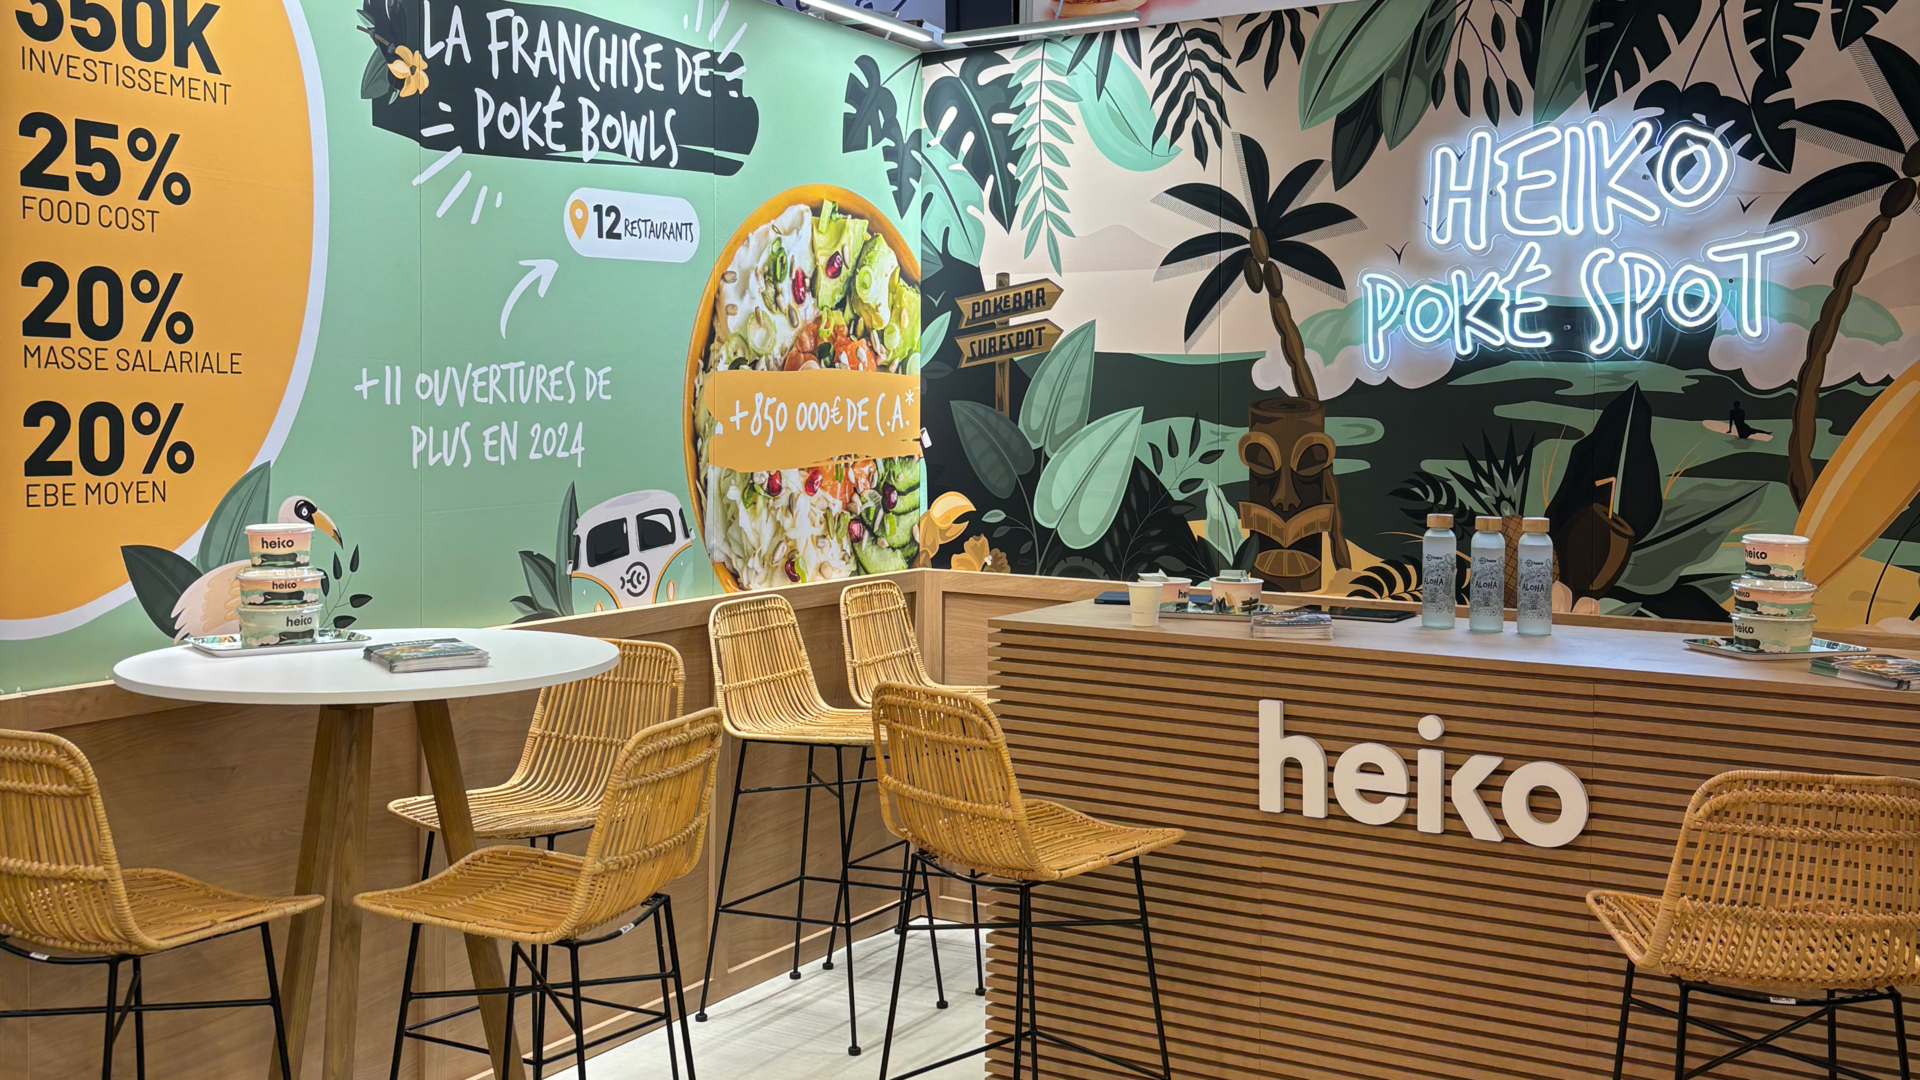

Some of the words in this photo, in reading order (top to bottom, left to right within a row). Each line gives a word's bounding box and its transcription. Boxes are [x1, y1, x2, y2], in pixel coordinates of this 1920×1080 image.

[423, 0, 472, 67] LA
[486, 8, 664, 94] FRANCHISE
[675, 47, 712, 98] DE
[21, 46, 232, 105] INVESTISSEMENT
[474, 85, 567, 151] POKÉ
[578, 96, 679, 168] BOWLS
[18, 111, 192, 206] 25%
[1431, 120, 1729, 250] HEIKO
[21, 195, 91, 226] FOOD
[98, 204, 160, 233] COST
[593, 203, 622, 241] 12
[624, 217, 694, 243] RESTAURANTS
[20, 260, 194, 345] 20%
[971, 286, 1047, 321] POKEBAR
[1362, 241, 1552, 364] POKÉ
[1580, 230, 1800, 354] SPOT
[23, 344, 109, 372] MASSE
[115, 348, 243, 375] SALARIALE
[969, 326, 1046, 360] SURFSPOT
[415, 360, 576, 408] OUVERTURES
[584, 366, 612, 402] DE
[23, 400, 195, 477] 20%
[729, 392, 788, 447] +850
[846, 397, 869, 433] DE
[411, 421, 471, 470] PLUS
[482, 420, 518, 466] EN
[529, 421, 585, 468] 2024
[26, 482, 76, 508] EBE
[84, 480, 166, 507] MOYEN
[261, 537, 295, 549] heiko
[272, 581, 297, 590] heiko
[1475, 580, 1498, 590] ALOHA
[1521, 583, 1545, 593] ALOHA
[286, 615, 313, 627] heiko
[1259, 699, 1590, 848] heiko
